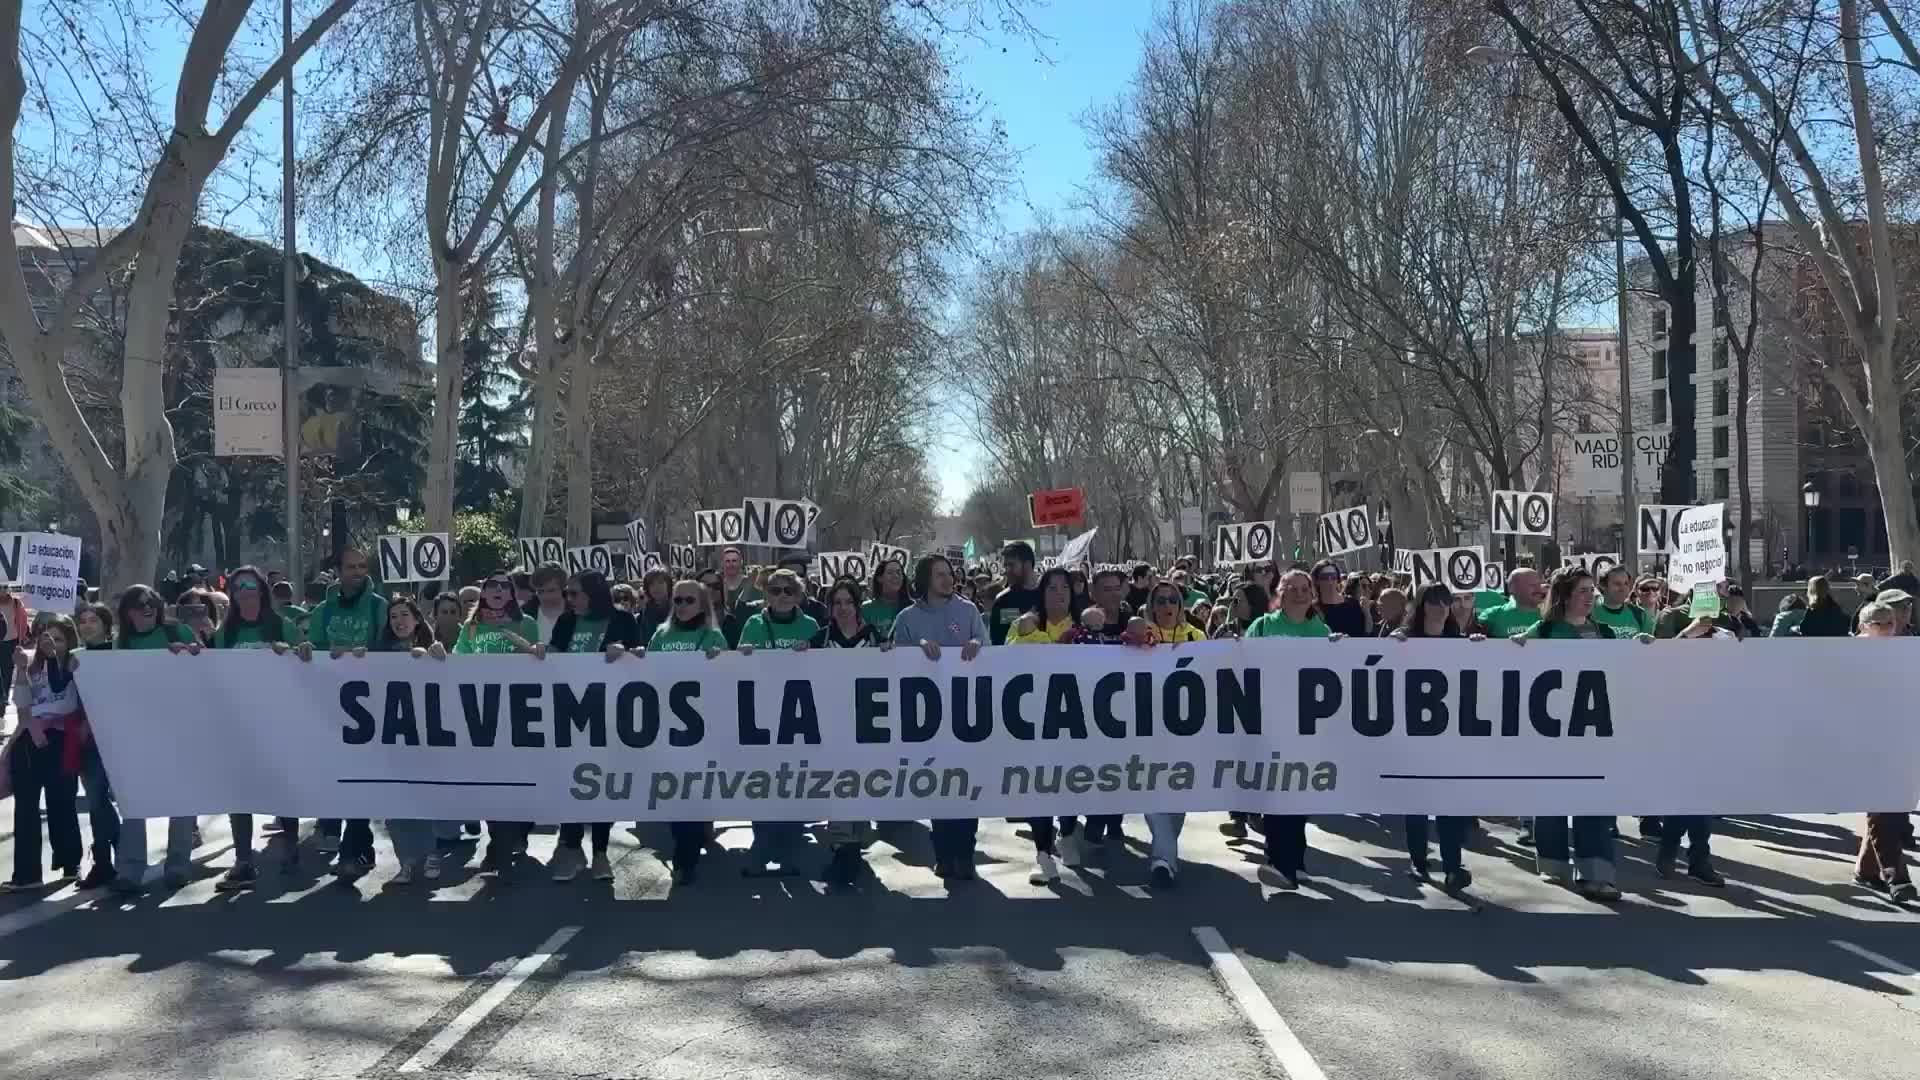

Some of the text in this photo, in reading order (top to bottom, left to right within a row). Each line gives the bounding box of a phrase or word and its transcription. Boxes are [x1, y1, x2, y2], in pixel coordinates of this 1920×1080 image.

[219, 396, 277, 413] El Greco
[1575, 438, 1619, 454] MAD
[1592, 453, 1619, 469] RID
[698, 510, 742, 543] NO
[743, 500, 806, 545] NO
[1494, 493, 1549, 533] NO
[1219, 523, 1272, 561] NO
[1324, 508, 1370, 553] NO
[28, 542, 37, 555] La
[380, 536, 446, 580] NO
[521, 539, 564, 573] NO
[568, 546, 611, 580] NO
[671, 547, 695, 569] NO
[1683, 543, 1693, 553] un
[820, 555, 866, 584] NO
[1412, 549, 1482, 591] NO
[1682, 563, 1694, 574] no
[339, 653, 1614, 748] SALVEMOS LA EDUCACIÓN PÚBLICA
[568, 751, 1339, 811] Su privatización, nuestra ruina
